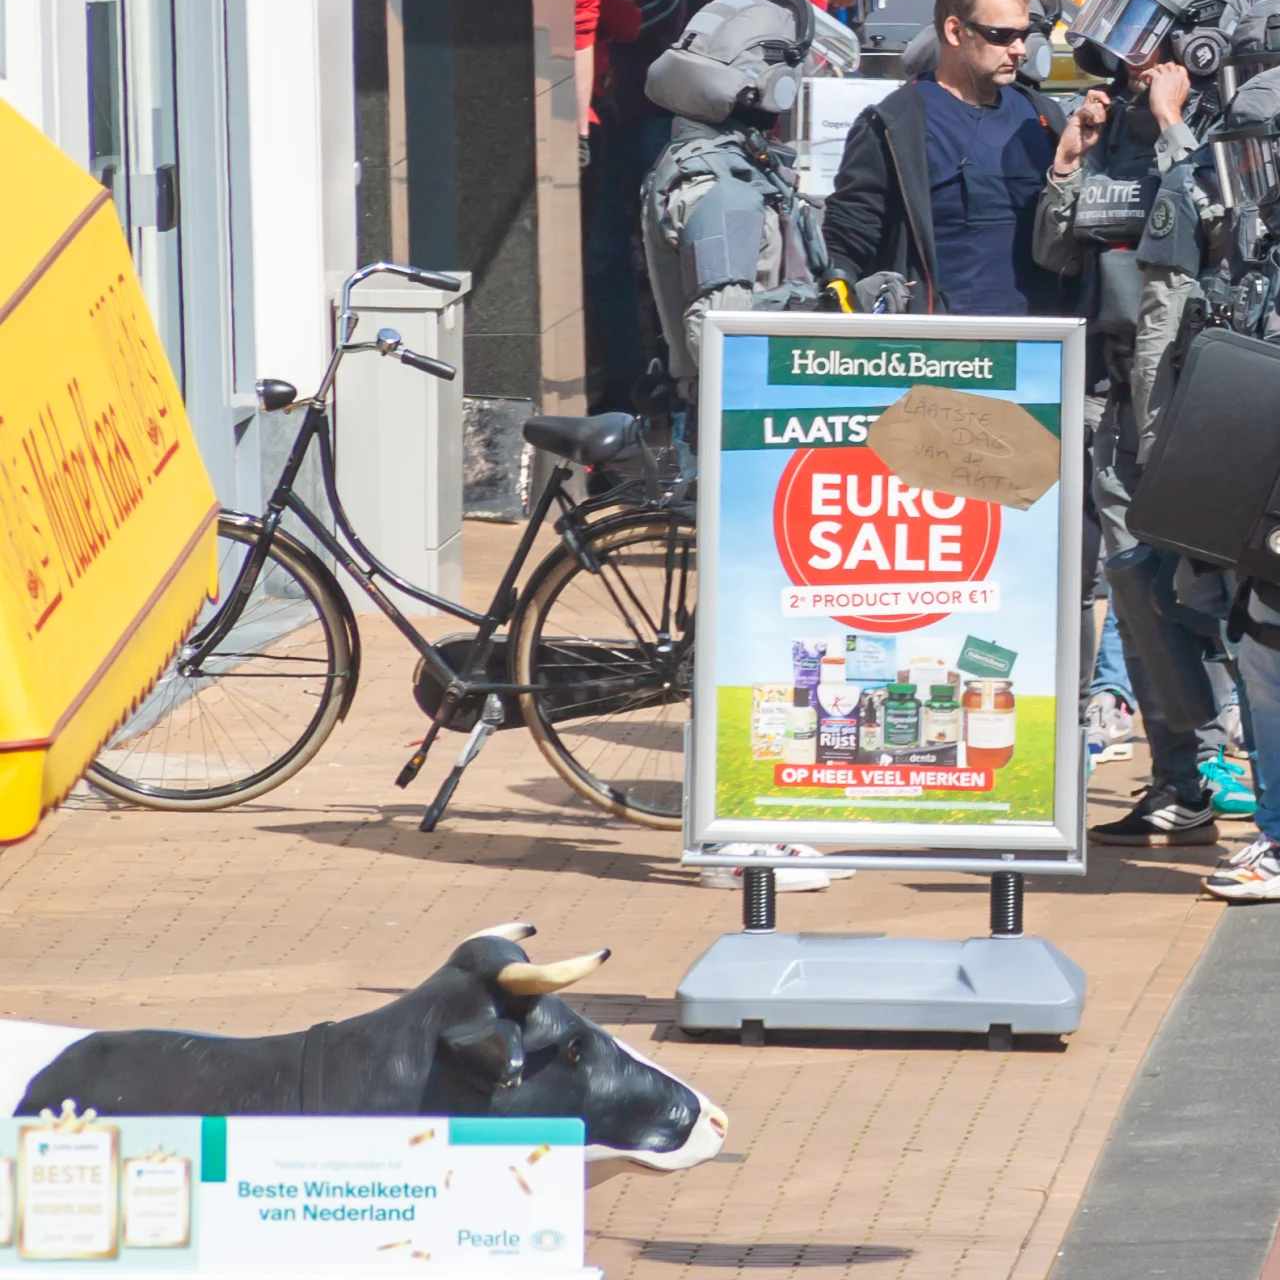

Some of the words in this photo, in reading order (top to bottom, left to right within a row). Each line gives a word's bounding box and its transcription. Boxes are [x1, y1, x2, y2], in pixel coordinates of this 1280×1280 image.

[903, 394, 992, 427] LAATSTE
[763, 415, 876, 444] LAATS
[811, 474, 966, 519] EURO
[807, 521, 963, 572] SALE
[812, 592, 902, 608] PRODUCT
[907, 590, 962, 605] VOOR
[820, 733, 857, 749] Rijst
[781, 768, 809, 783] OP
[812, 770, 858, 785] HEEL
[861, 770, 906, 786] VEEL
[909, 771, 986, 788] MERKEN
[31, 1165, 103, 1184] BESTE
[237, 1181, 299, 1198] Beste
[304, 1181, 437, 1199] Winkelketen
[259, 1208, 296, 1221] van
[302, 1204, 416, 1221] Nederland
[458, 1230, 520, 1248] Pearle
